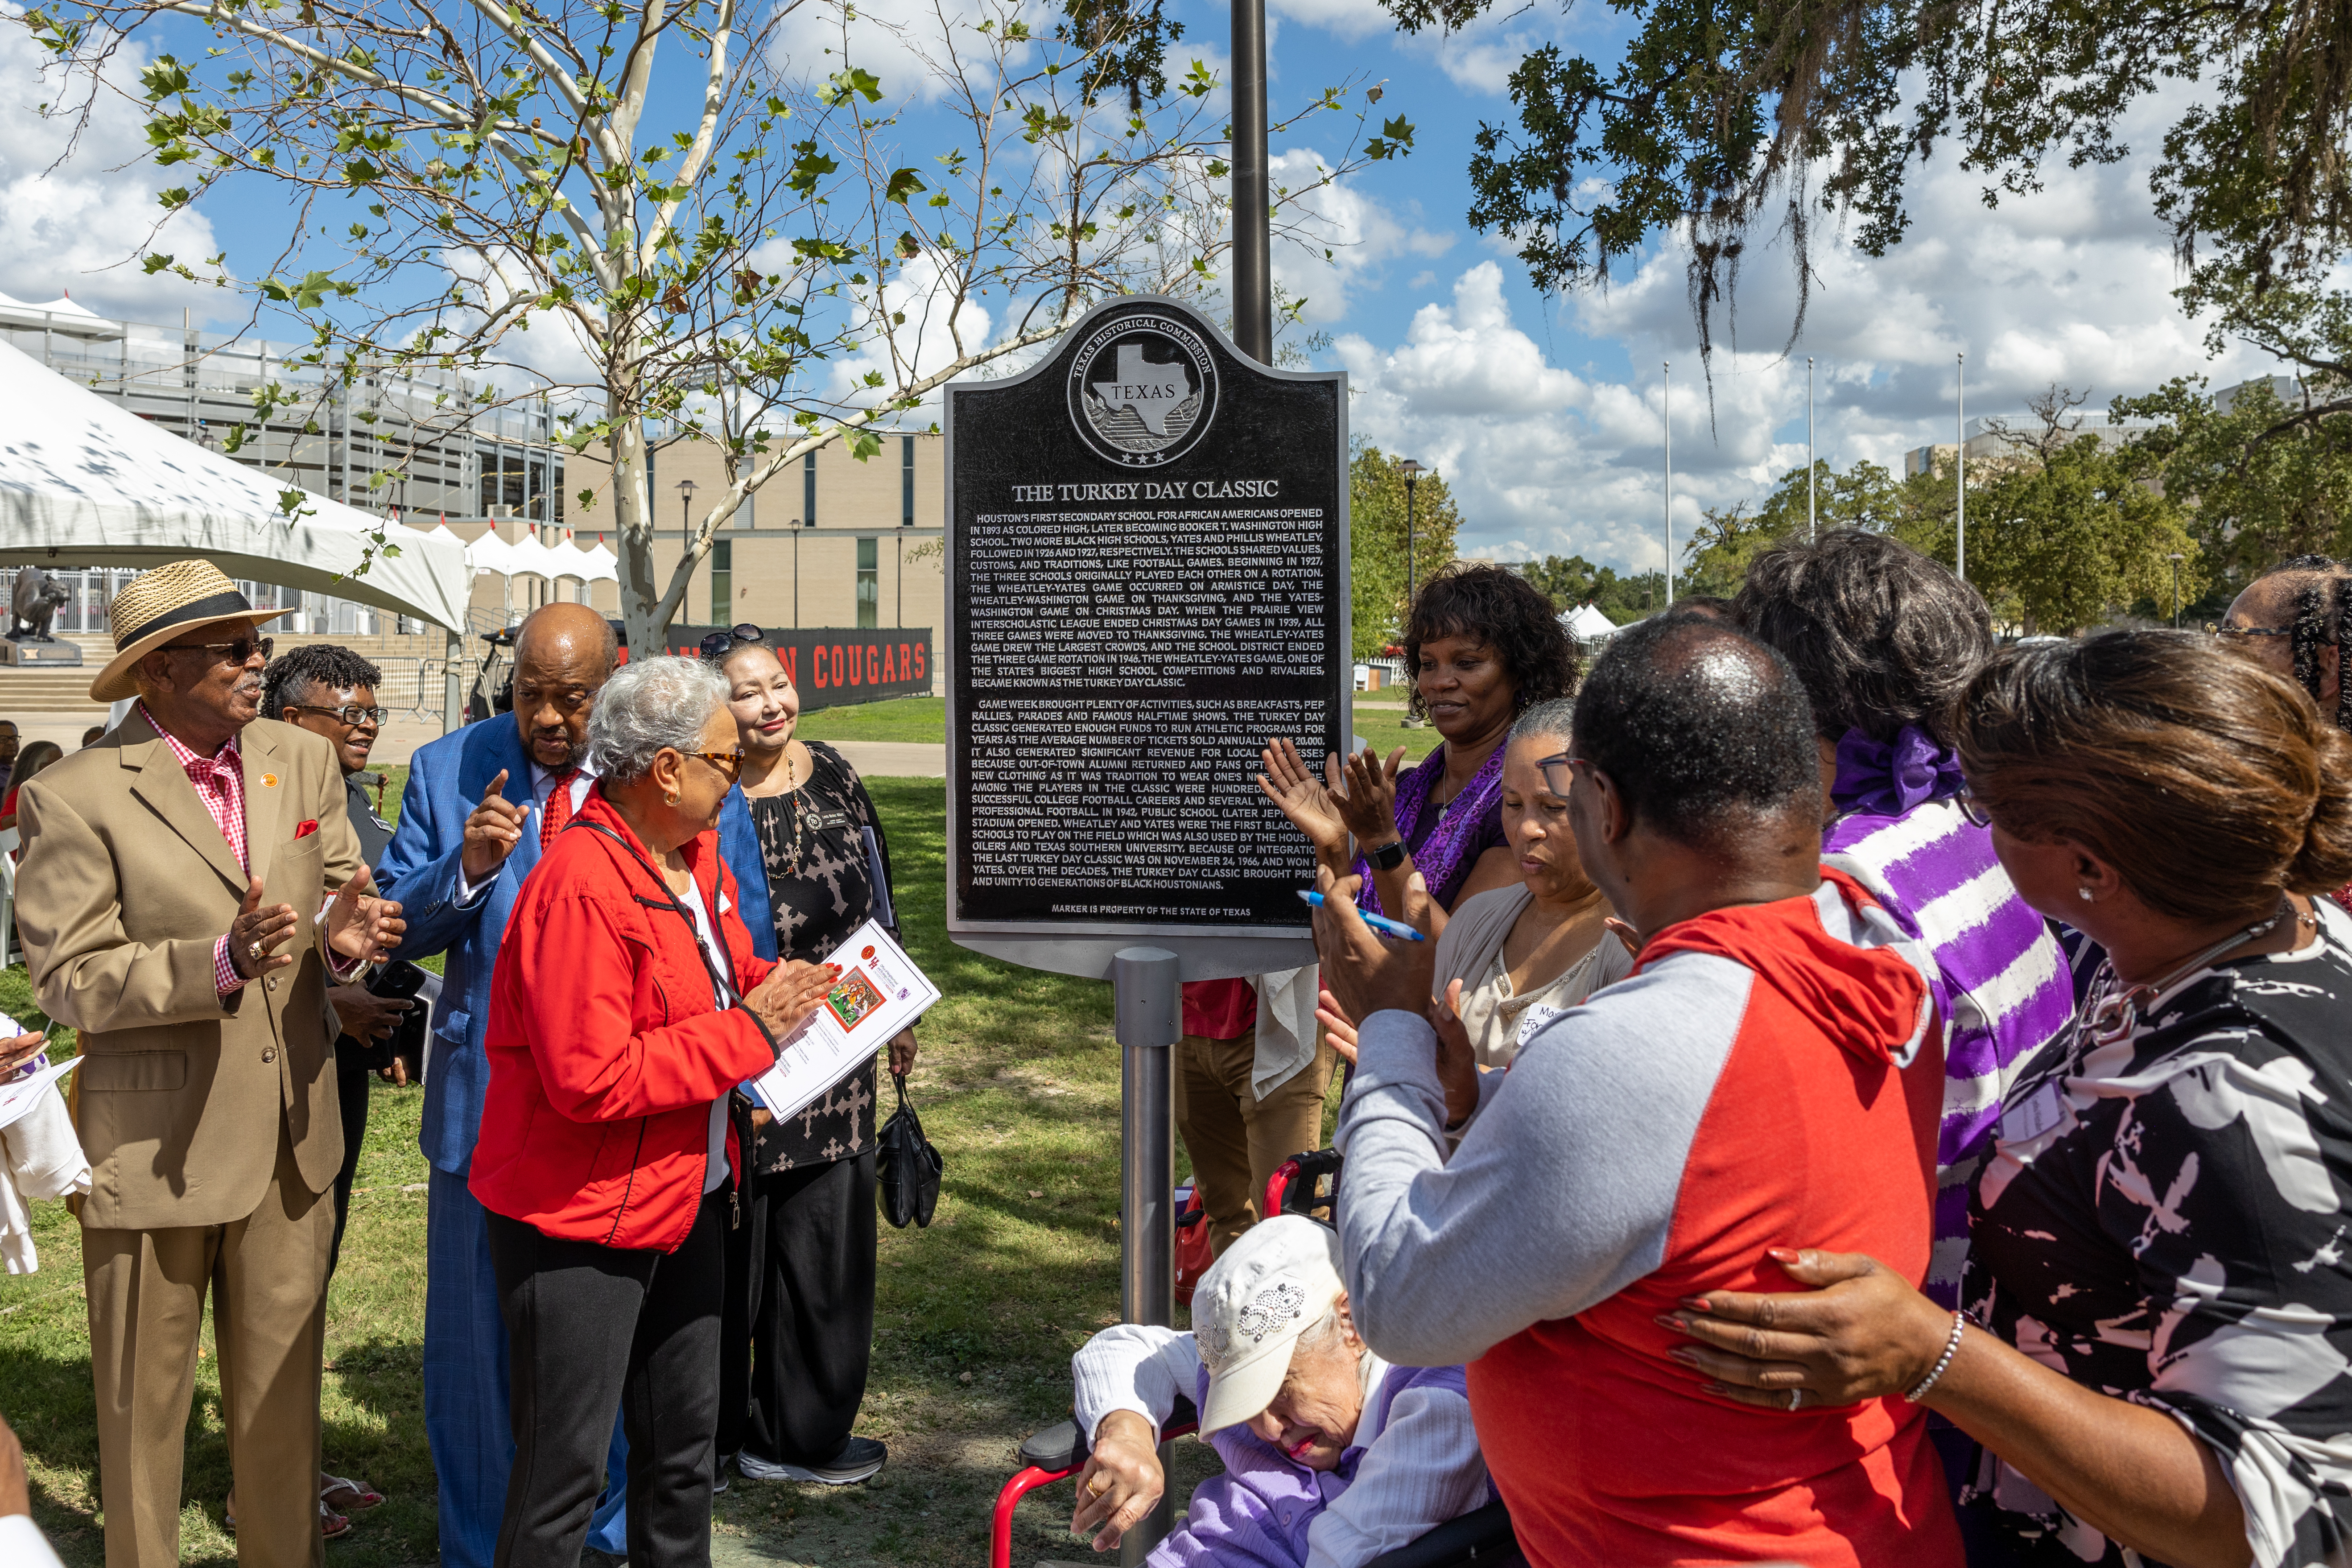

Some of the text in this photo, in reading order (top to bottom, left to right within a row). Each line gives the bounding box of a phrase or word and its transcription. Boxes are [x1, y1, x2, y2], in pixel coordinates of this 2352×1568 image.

[1074, 319, 1211, 378] TEXAS HISTORICAL COMMISSION
[1111, 384, 1175, 401] TEXAS
[1011, 480, 1279, 502] THE TURKEY DAY CLASSIC
[977, 509, 1323, 523] HOUSTON'S FIRST SECONDARY SCHOOL FOR AFRICAN AMERICANS OPENED
[970, 533, 1323, 546] SCHOOL. TWO MORE BLACK HIGH SCHOOLS, YATES AND PHILLIS WHEATLEY,
[970, 557, 1323, 569] CUSTOMS, AND TRADITIONS, LIKE FOOTBALL GAMES. BEGINNING IN 1927,
[993, 573, 1027, 581] THREE
[1029, 572, 1072, 581] SCHOOLS
[1074, 571, 1132, 580] ORIGINALLY
[1135, 571, 1174, 579] PLAYED
[1177, 570, 1204, 579] EACH
[1207, 569, 1242, 578] OTHER
[1244, 569, 1258, 578] ON
[1261, 569, 1268, 578] A
[1272, 569, 1324, 578] ROTATION.
[997, 584, 1087, 593] WHEATLEY-YATES
[1092, 583, 1122, 592] GAME
[1129, 582, 1183, 591] OCCURRED
[1189, 582, 1204, 590] ON
[1212, 582, 1265, 590] ARMISTICE
[1273, 581, 1295, 590] DAY,
[1301, 581, 1323, 589] THE
[970, 595, 1089, 604] WHEATLEY-WASHINGTON
[1095, 594, 1125, 603] GAME
[1131, 594, 1145, 603] ON
[1151, 594, 1227, 603] THANKSGIVING,
[1260, 593, 1282, 602] THE
[1288, 593, 1324, 601] YATES-
[970, 605, 1324, 616] WASHINGTON GAME ON CHRISTMAS DAY. WHEN THE PRAIRIE VIEW
[971, 620, 1057, 628] INTERSCHOLASTIC
[1060, 619, 1100, 628] LEAGUE
[1104, 619, 1139, 627] ENDED
[1142, 619, 1198, 627] CHRISTMAS
[1201, 618, 1222, 627] DAY
[1279, 618, 1301, 627] 1939,
[1304, 618, 1325, 626] ALL
[970, 630, 1324, 640] THREE GAMES WERE MOVED TO THANKSGIVING. THE WHEATLEY-YATES
[971, 644, 1000, 652] GAME
[1003, 643, 1032, 652] DREW
[1034, 643, 1056, 652] THE
[1058, 643, 1102, 651] LARGEST
[1105, 643, 1148, 651] CROWDS,
[1151, 643, 1172, 651] AND
[1175, 643, 1196, 651] THE
[1198, 642, 1238, 651] SCHOOL
[1240, 642, 1284, 651] DISTRICT
[813, 643, 924, 688] COUGARS
[971, 667, 991, 675] THE
[997, 667, 1034, 675] STATE'S
[1040, 667, 1082, 675] BIGGEST
[1088, 667, 1112, 675] HIGH
[1118, 666, 1158, 675] SCHOOL
[1163, 667, 1236, 675] COMPETITIONS
[1271, 667, 1325, 675] RIVALRIES,
[972, 712, 1014, 720] RALLIES,
[1018, 712, 1063, 720] PARADES
[1066, 712, 1088, 720] AND
[1093, 712, 1132, 720] FAMOUS
[1137, 712, 1188, 721] HALFTIME
[1193, 712, 1229, 720] SHOWS.
[1259, 713, 1300, 721] TURKEY
[1304, 713, 1326, 721] DAY
[972, 877, 1224, 889] AND UNITY TO GENERATIONS OF BLACK HOUSTONIANS.
[1089, 905, 1098, 913] IS
[1100, 906, 1145, 914] PROPERTY
[1147, 906, 1158, 914] OF
